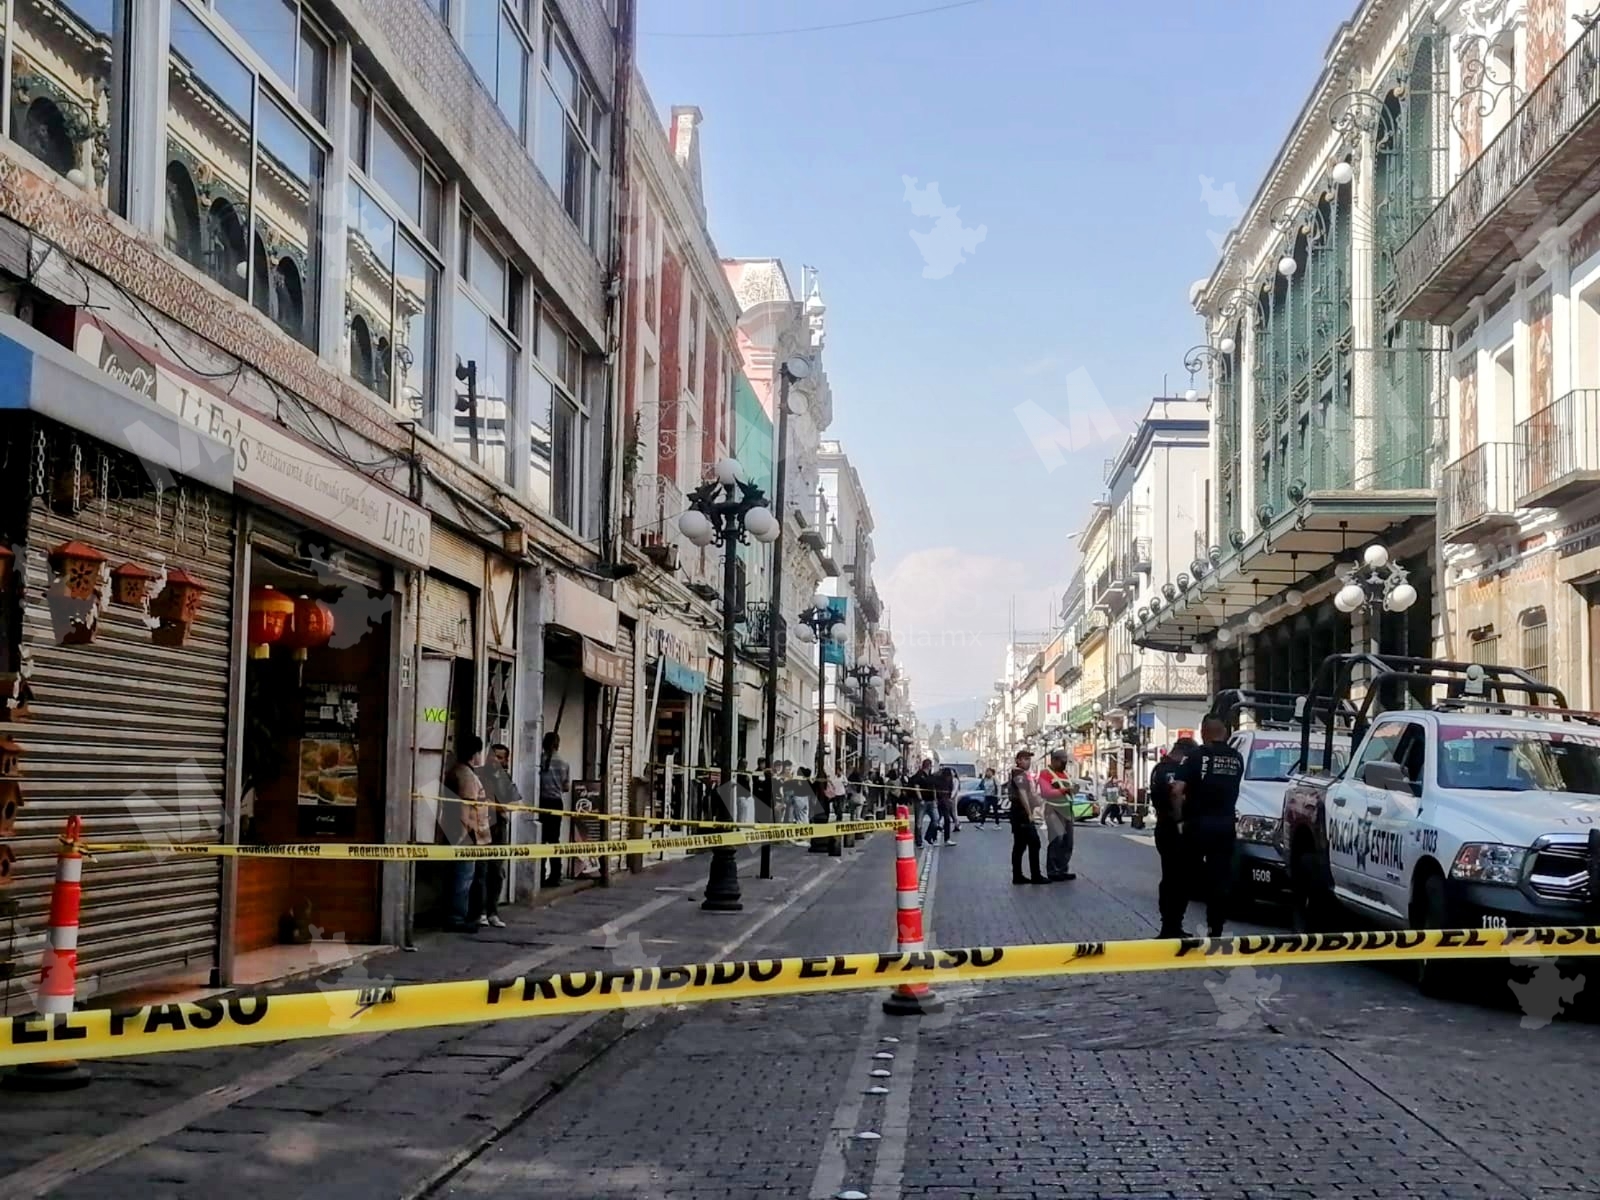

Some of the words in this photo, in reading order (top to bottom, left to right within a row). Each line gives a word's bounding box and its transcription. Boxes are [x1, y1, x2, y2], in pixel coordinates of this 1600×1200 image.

[256, 441, 303, 482] Restaurante
[382, 502, 425, 558] LiFa's
[1047, 694, 1060, 714] H
[795, 827, 814, 836] PASO
[1423, 829, 1438, 853] 1103
[348, 846, 394, 857] PROHIBIDO
[407, 847, 429, 858] PASO
[454, 848, 499, 857] PROHIBIDO
[509, 847, 530, 857] PASO
[607, 842, 628, 852] PASO
[1371, 829, 1404, 871] ESTATAL
[1482, 915, 1507, 929] 1103
[1175, 930, 1425, 957] PROHIBIDO
[1436, 929, 1488, 947] EL
[488, 959, 783, 1004] PROHIBIDO
[800, 957, 858, 977] EL
[875, 948, 1003, 973] PASO
[12, 1012, 87, 1044] EL
[109, 996, 268, 1036] PASO
